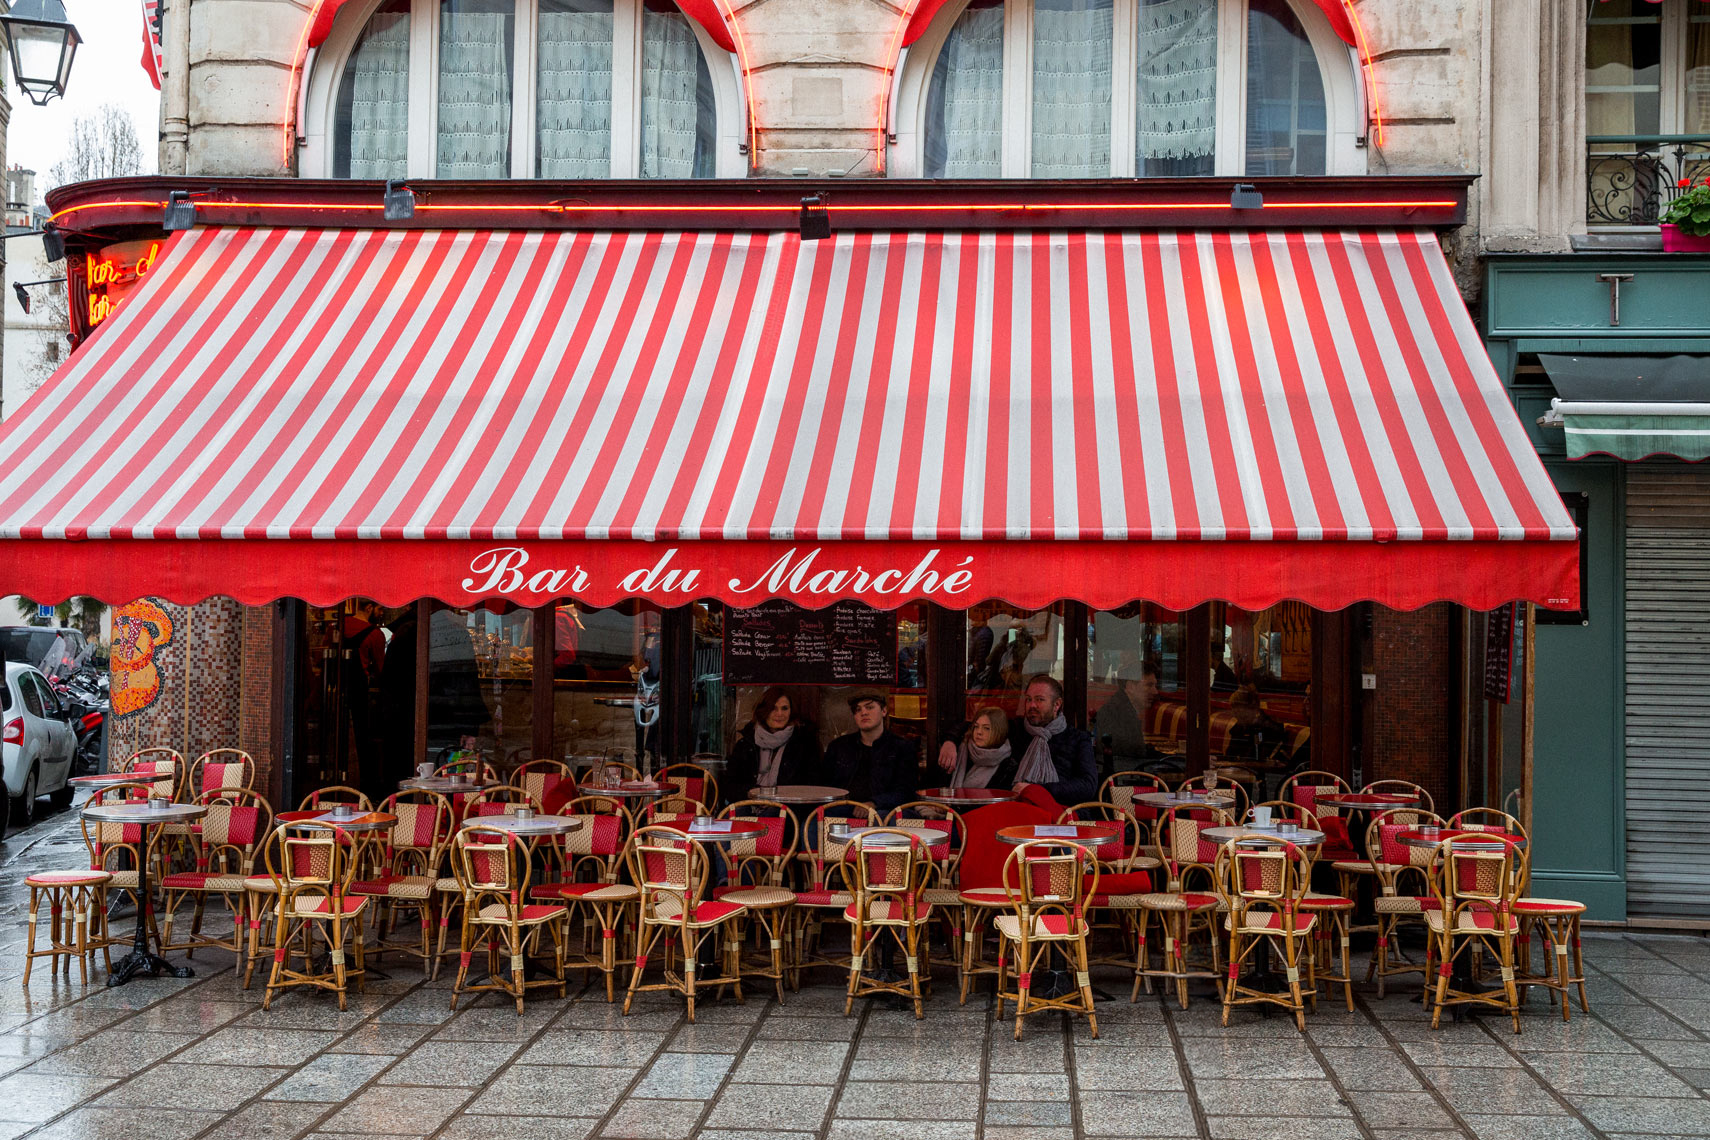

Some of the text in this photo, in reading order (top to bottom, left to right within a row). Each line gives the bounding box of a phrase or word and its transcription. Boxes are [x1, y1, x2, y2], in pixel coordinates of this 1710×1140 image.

[136, 243, 158, 277] d
[461, 546, 973, 594] Bar du Marché
